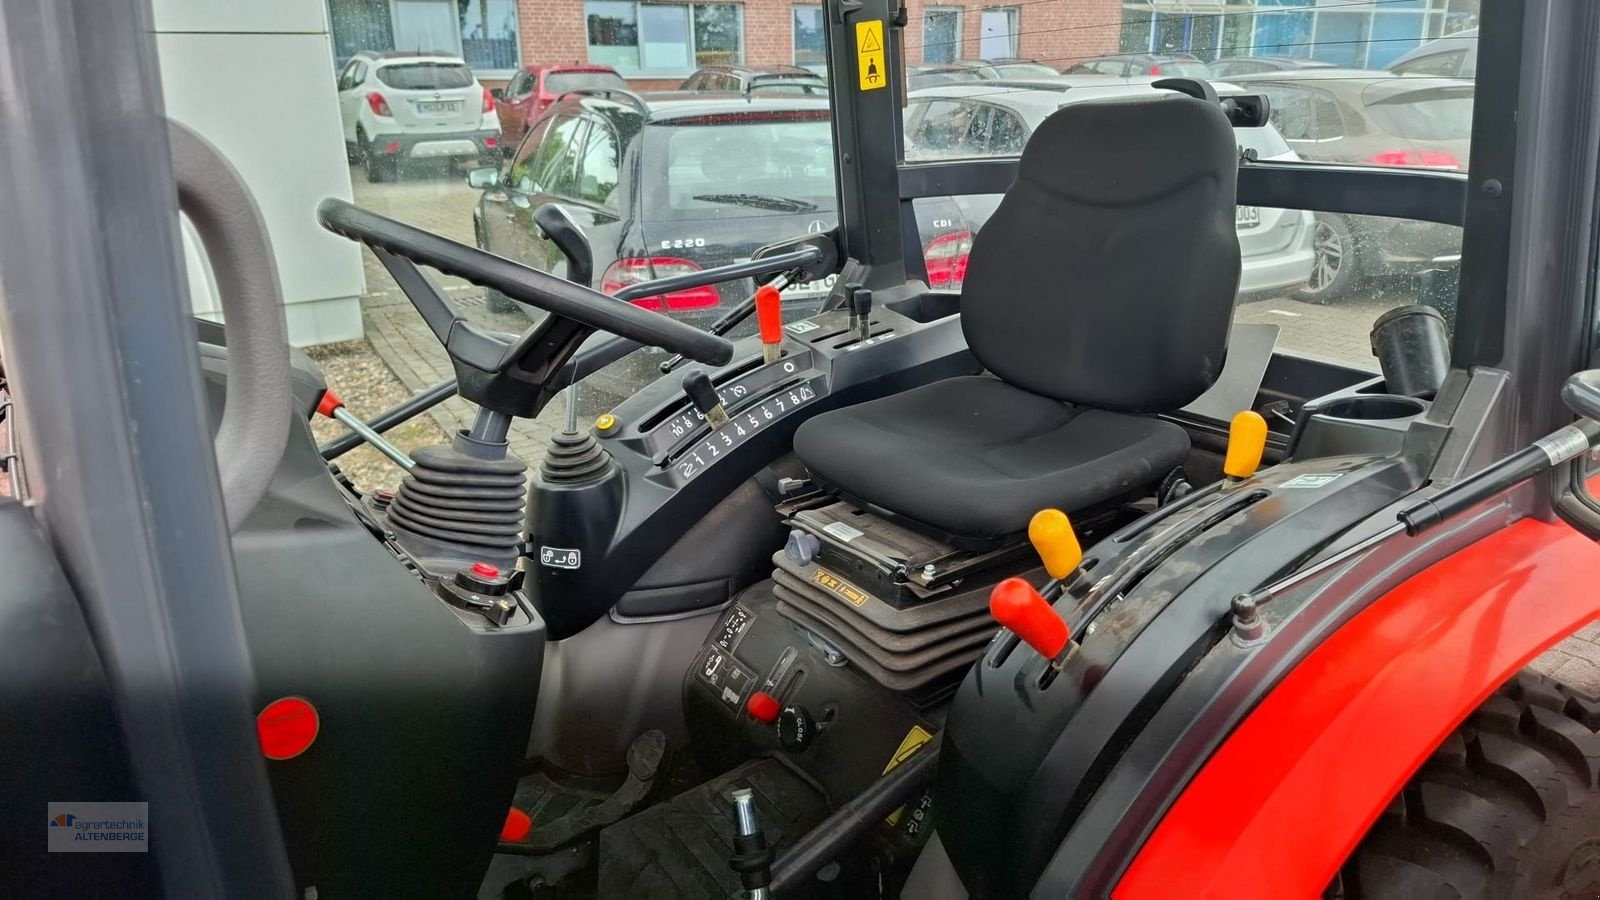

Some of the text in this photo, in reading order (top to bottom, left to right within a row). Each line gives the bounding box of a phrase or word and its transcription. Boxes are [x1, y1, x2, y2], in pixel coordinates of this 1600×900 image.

[933, 219, 952, 228] CDI
[708, 446, 719, 456] 2
[722, 435, 732, 446] 3
[737, 425, 746, 436] 4
[750, 417, 759, 428] 5
[764, 409, 773, 420] 6
[776, 401, 785, 412] 7
[790, 394, 800, 405] 8
